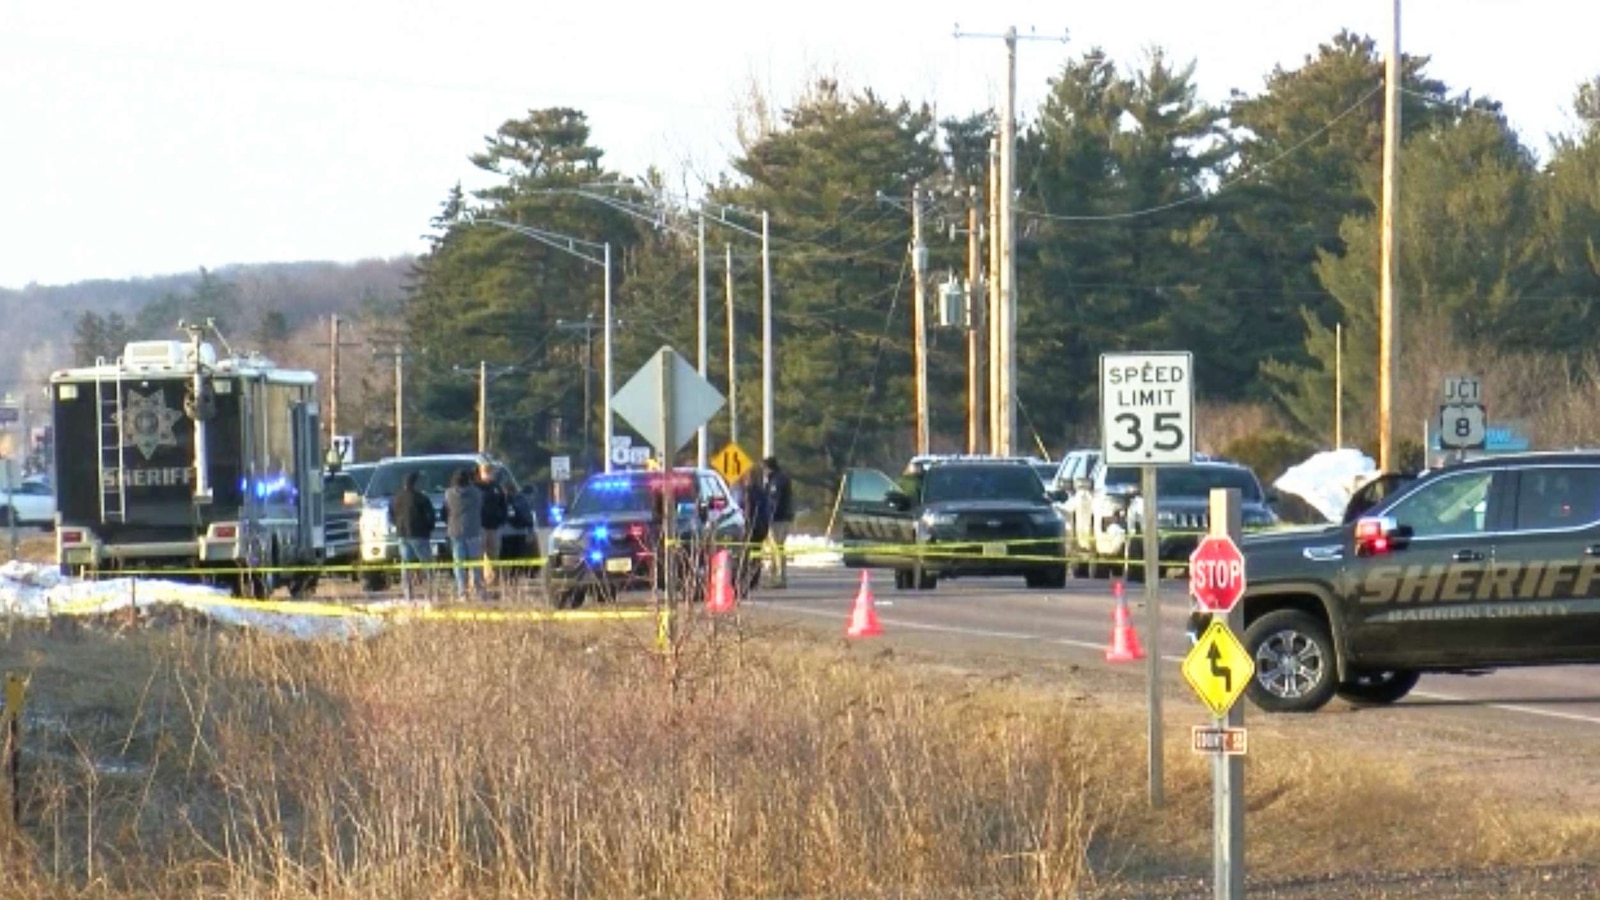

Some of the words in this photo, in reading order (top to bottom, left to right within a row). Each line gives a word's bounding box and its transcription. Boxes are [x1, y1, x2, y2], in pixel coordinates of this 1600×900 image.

[1109, 365, 1184, 384] SPEED
[1118, 389, 1175, 406] LIMIT
[1445, 381, 1478, 398] JCT
[1112, 412, 1184, 452] 35
[1455, 418, 1470, 437] 8
[103, 466, 193, 486] SHERIFF
[1196, 560, 1240, 588] STOP
[1360, 560, 1600, 602] SHERIFF
[1387, 606, 1480, 621] BARRON
[1486, 602, 1568, 618] COUNTY
